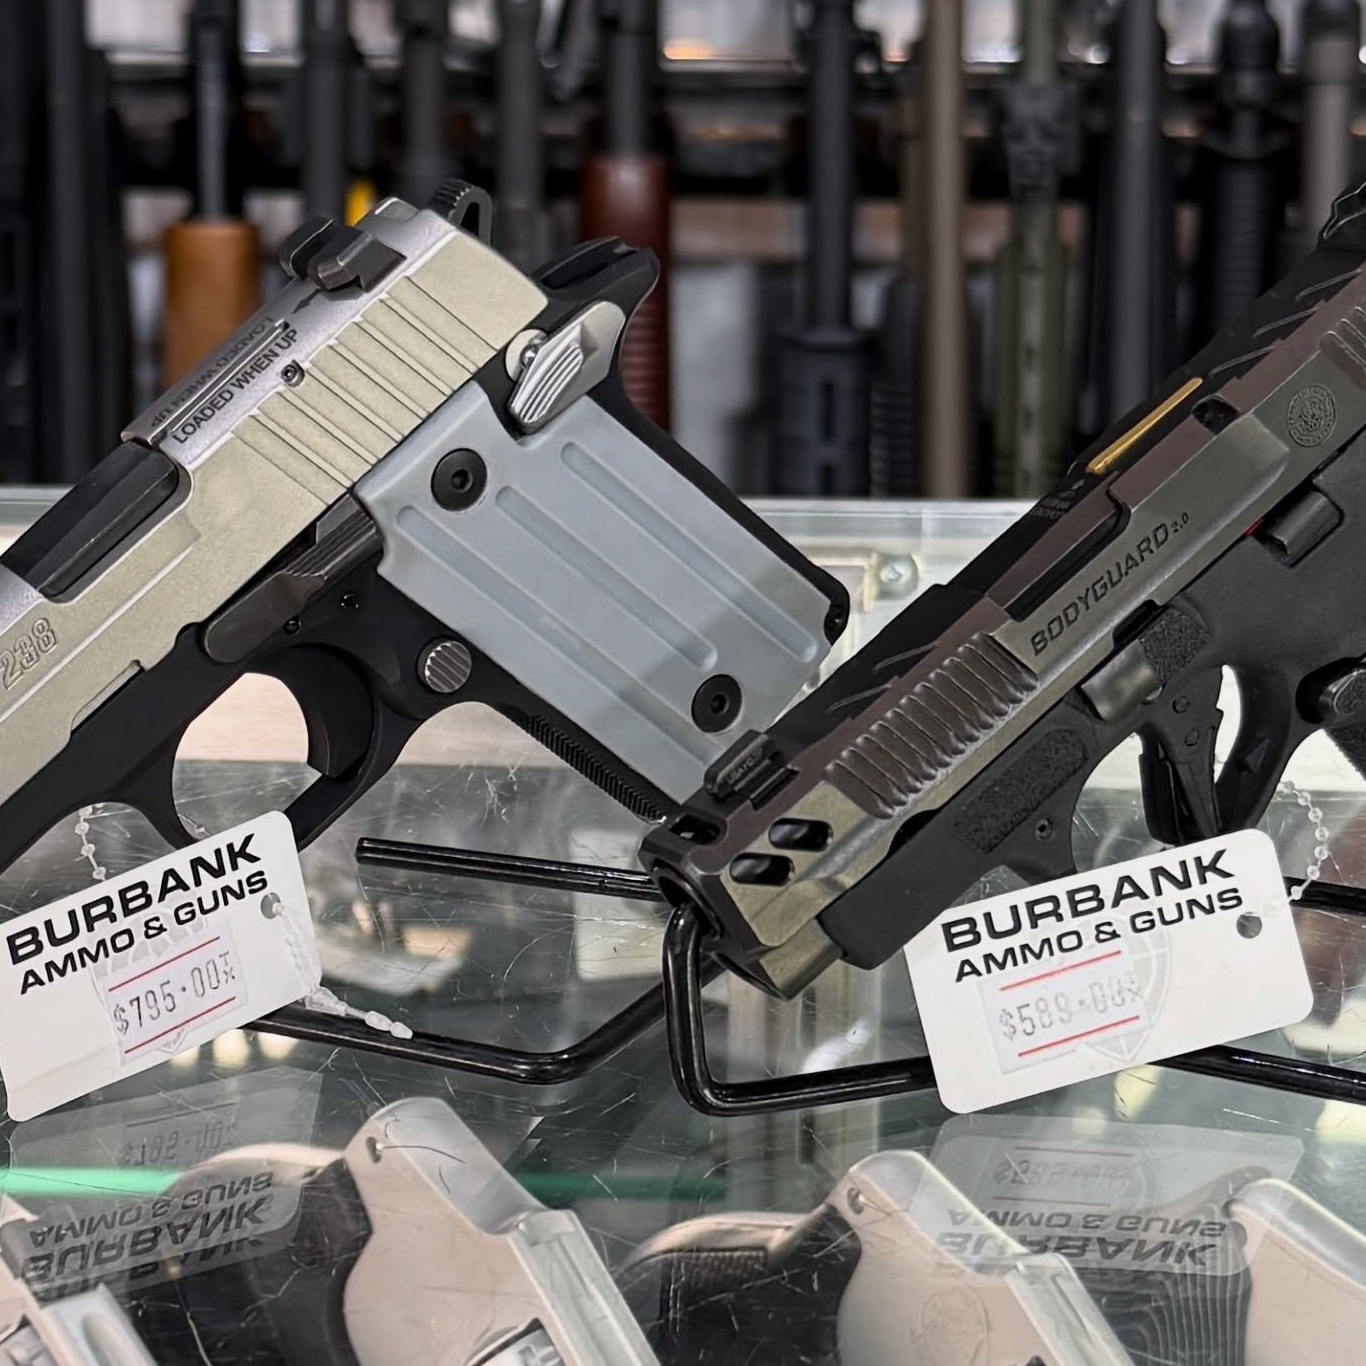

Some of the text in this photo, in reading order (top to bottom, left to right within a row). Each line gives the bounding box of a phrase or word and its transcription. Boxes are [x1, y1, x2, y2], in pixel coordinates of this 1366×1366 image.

[172, 328, 298, 444] LOADED WHEN UP
[1029, 511, 1190, 657] BODYGUARD 2.0
[6, 833, 262, 965] BURBANK
[19, 870, 269, 995] AMMO & GUNS
[941, 848, 1235, 953] BURBANK
[954, 887, 1243, 983] AMMO & GUNS
